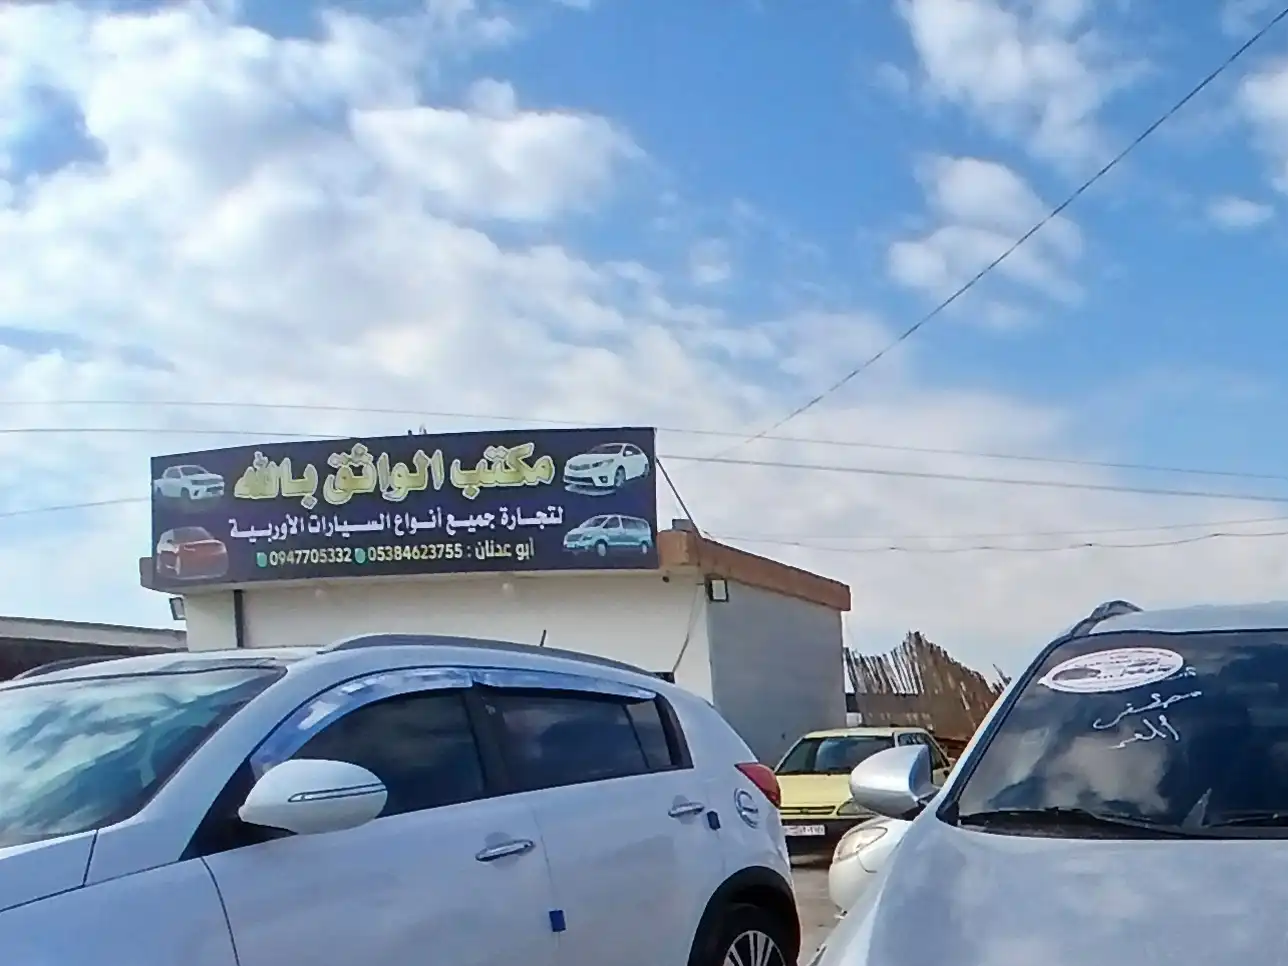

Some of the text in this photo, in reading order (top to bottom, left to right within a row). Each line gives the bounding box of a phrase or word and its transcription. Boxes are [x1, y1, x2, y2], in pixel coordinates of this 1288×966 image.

[233, 442, 556, 510] مكتب الواثق بالله
[307, 511, 391, 538] السيارات
[394, 506, 442, 537] أنواع
[445, 513, 496, 536] جميع
[499, 505, 564, 530] لتجارة
[269, 547, 352, 566] 0947705332
[367, 543, 463, 562] 05384623755
[475, 538, 512, 560] عدنان
